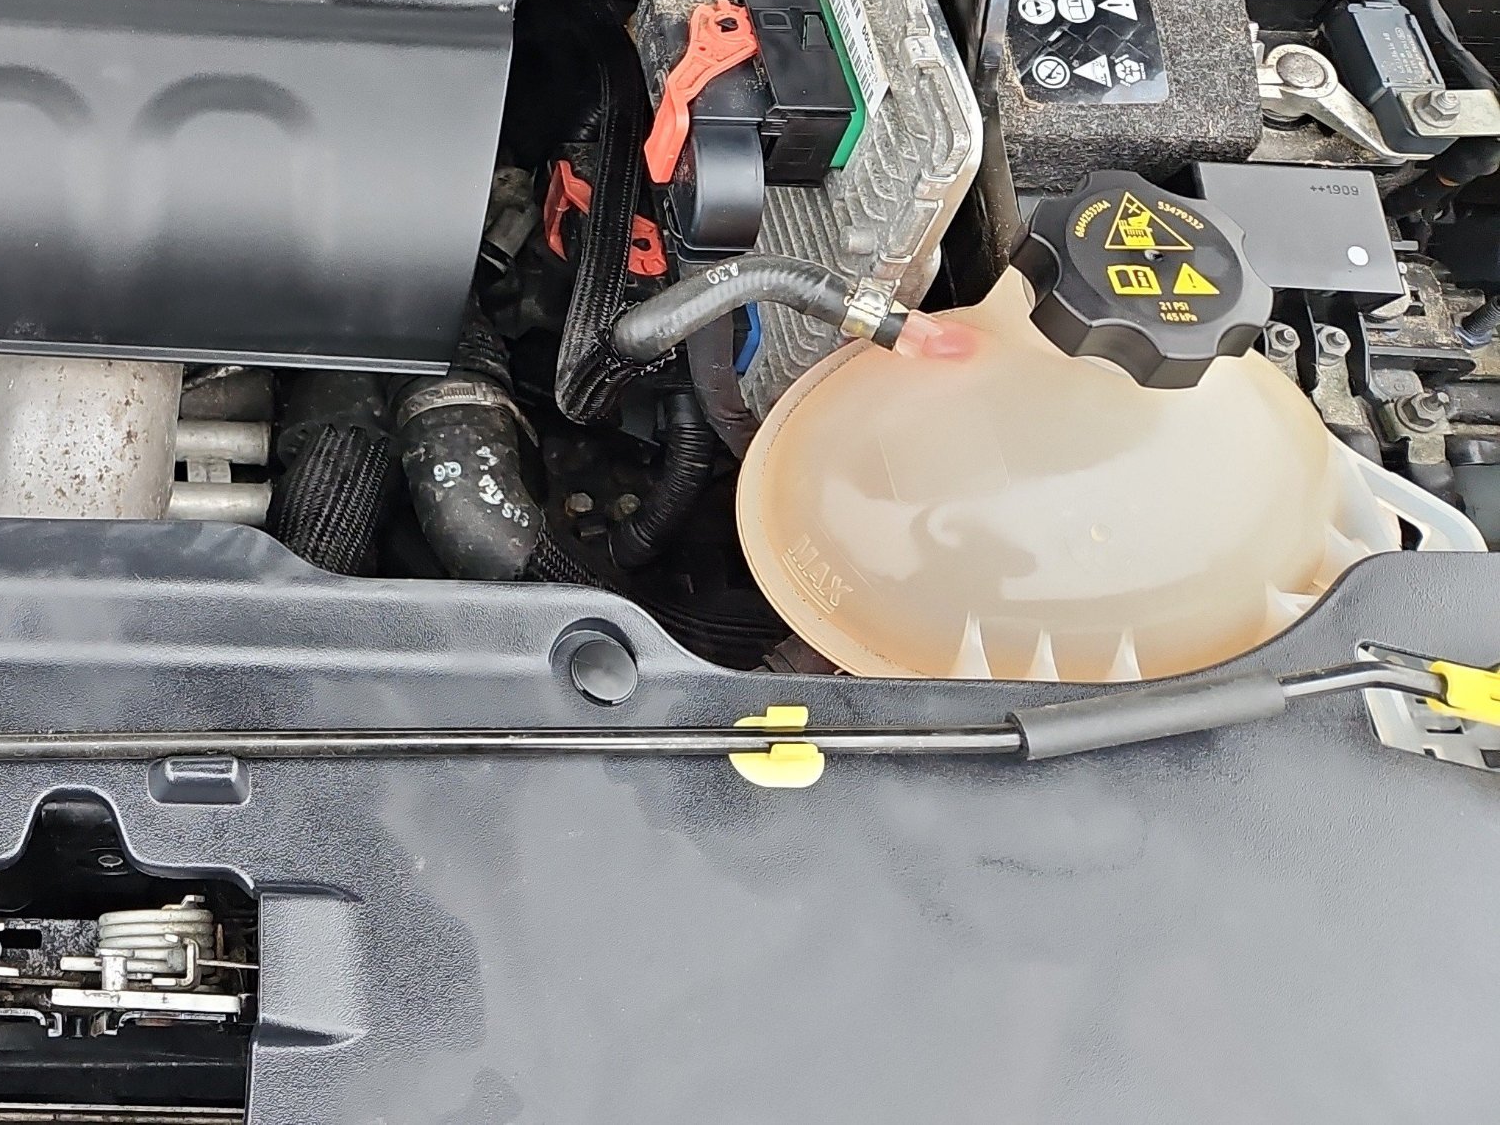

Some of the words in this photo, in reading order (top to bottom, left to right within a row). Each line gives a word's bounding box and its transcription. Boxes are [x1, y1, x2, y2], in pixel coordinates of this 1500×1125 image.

[1174, 301, 1190, 311] PSI
[1160, 312, 1179, 322] 145
[1180, 313, 1198, 322] kPa
[787, 532, 854, 607] MAX
